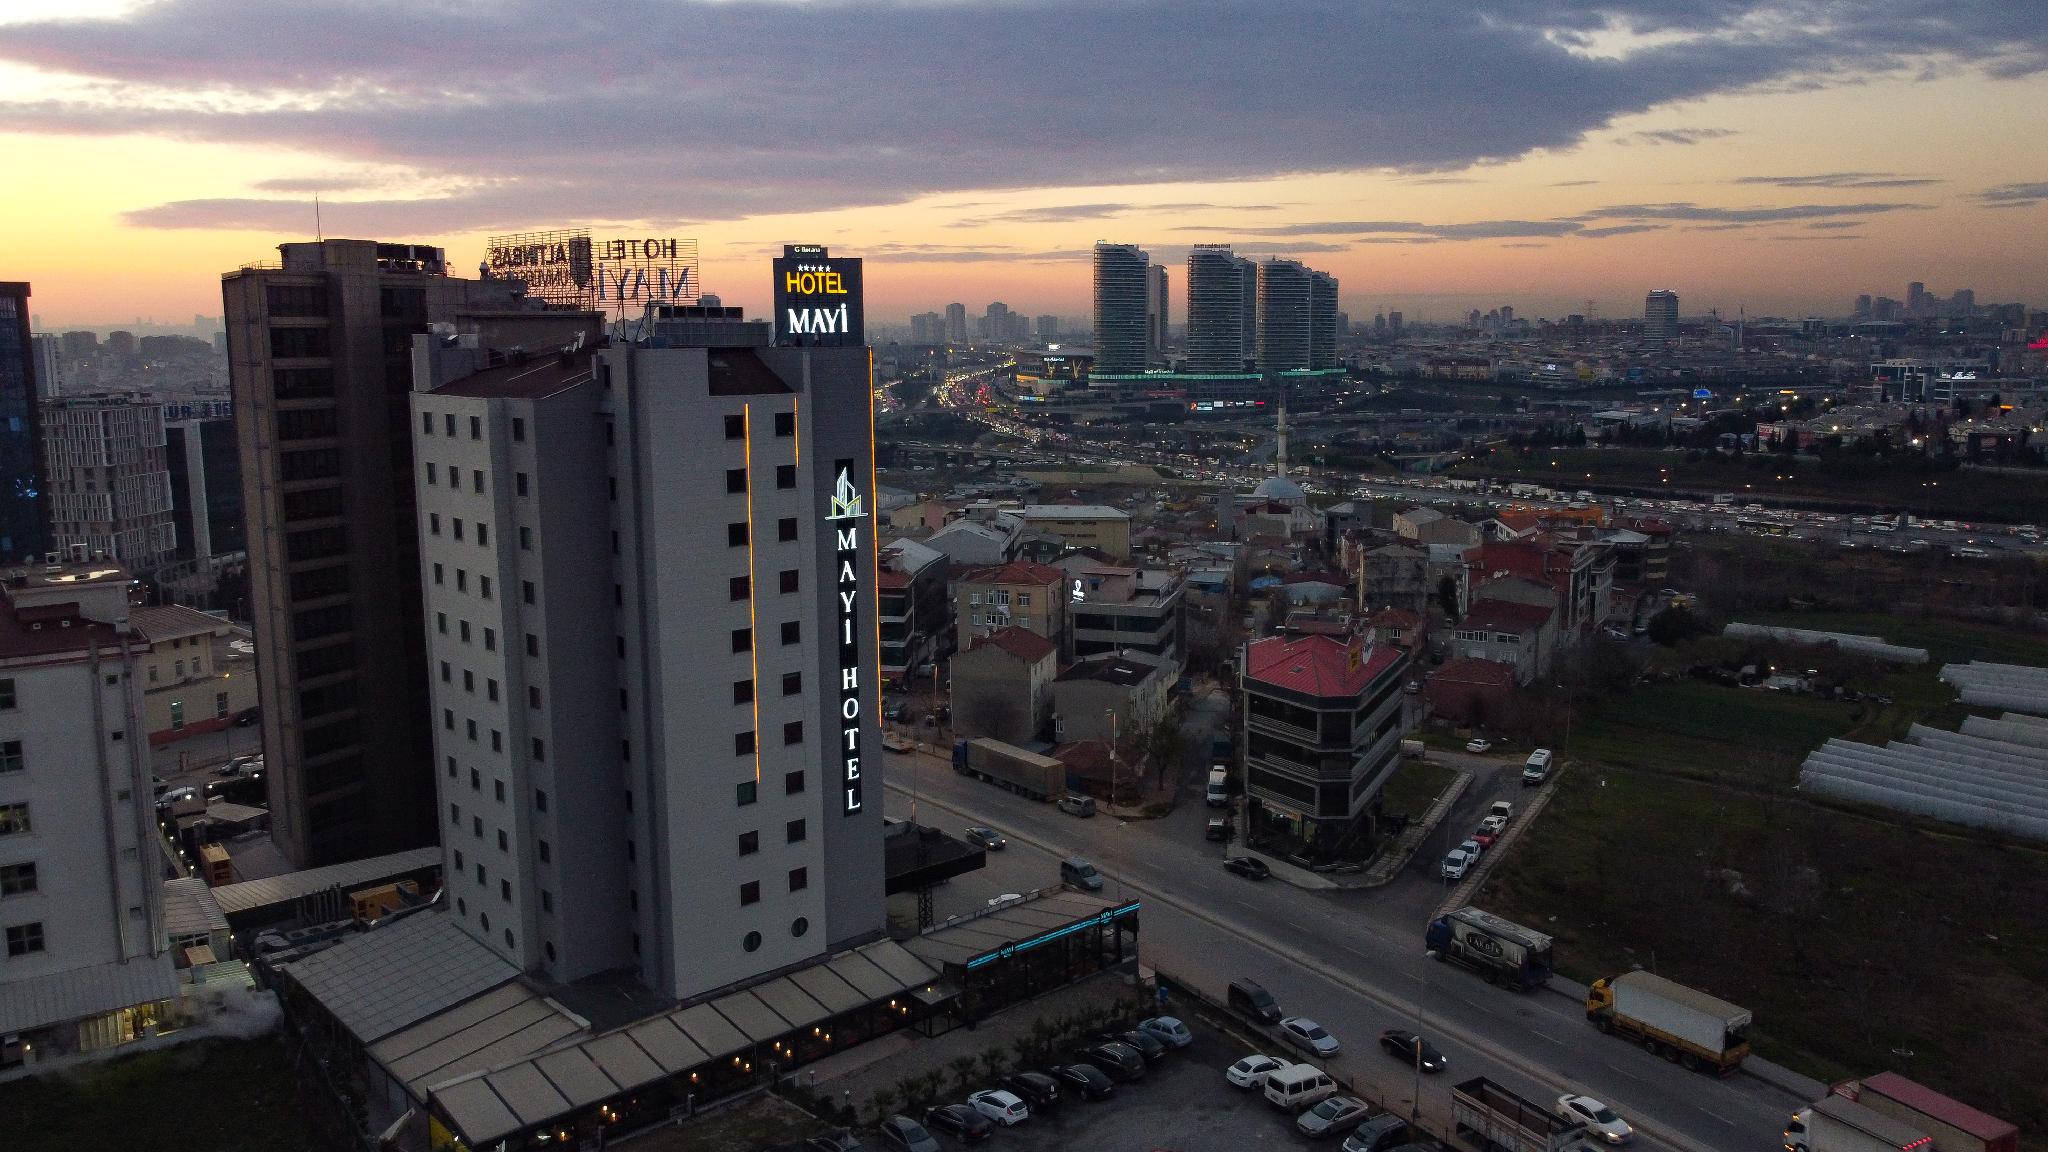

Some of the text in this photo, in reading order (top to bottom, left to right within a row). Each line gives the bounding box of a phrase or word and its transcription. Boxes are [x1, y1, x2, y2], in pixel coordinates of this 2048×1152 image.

[786, 271, 848, 295] HOTEL
[787, 302, 849, 334] MAYİ
[842, 666, 861, 810] HOTEL
